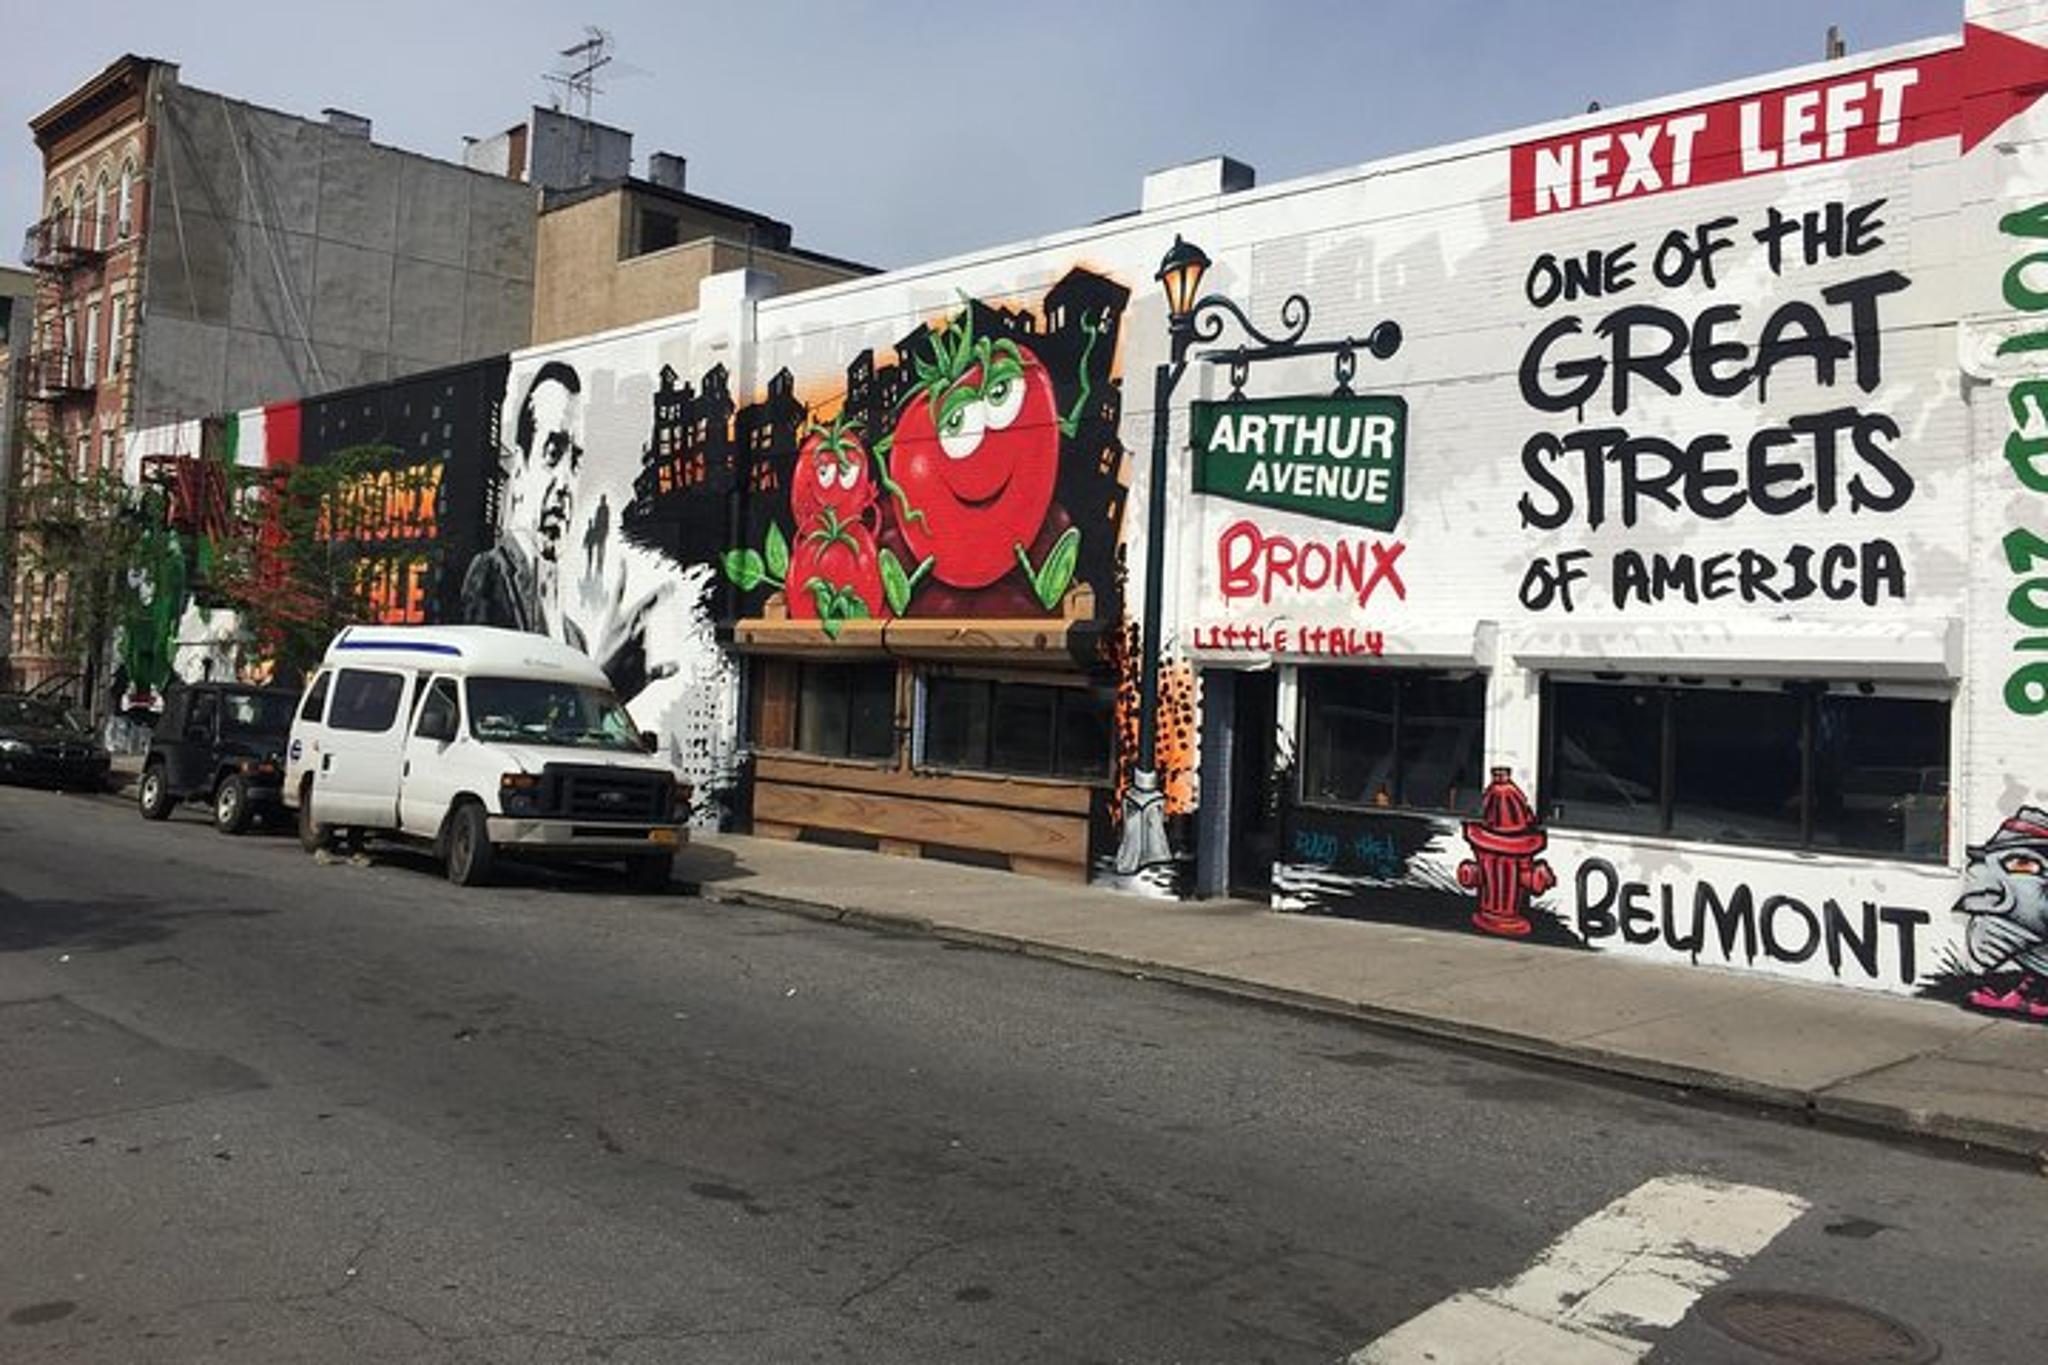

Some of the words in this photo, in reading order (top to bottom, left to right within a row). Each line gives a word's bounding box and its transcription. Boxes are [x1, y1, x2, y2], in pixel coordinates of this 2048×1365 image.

[1533, 112, 1708, 214] NEXT
[1740, 68, 1918, 175] LEFT
[1525, 243, 1638, 307] ONE
[1653, 217, 1739, 288] OF
[1518, 270, 1912, 418] GREAT
[1208, 414, 1397, 460] ARTHUR
[1246, 461, 1391, 503] AVENUE
[1518, 406, 1915, 531] STREETS
[1218, 520, 1406, 608] BRONX
[1518, 550, 1592, 612] OF
[1612, 539, 1906, 609] AMERICA
[1576, 857, 1930, 985] BELMONT
